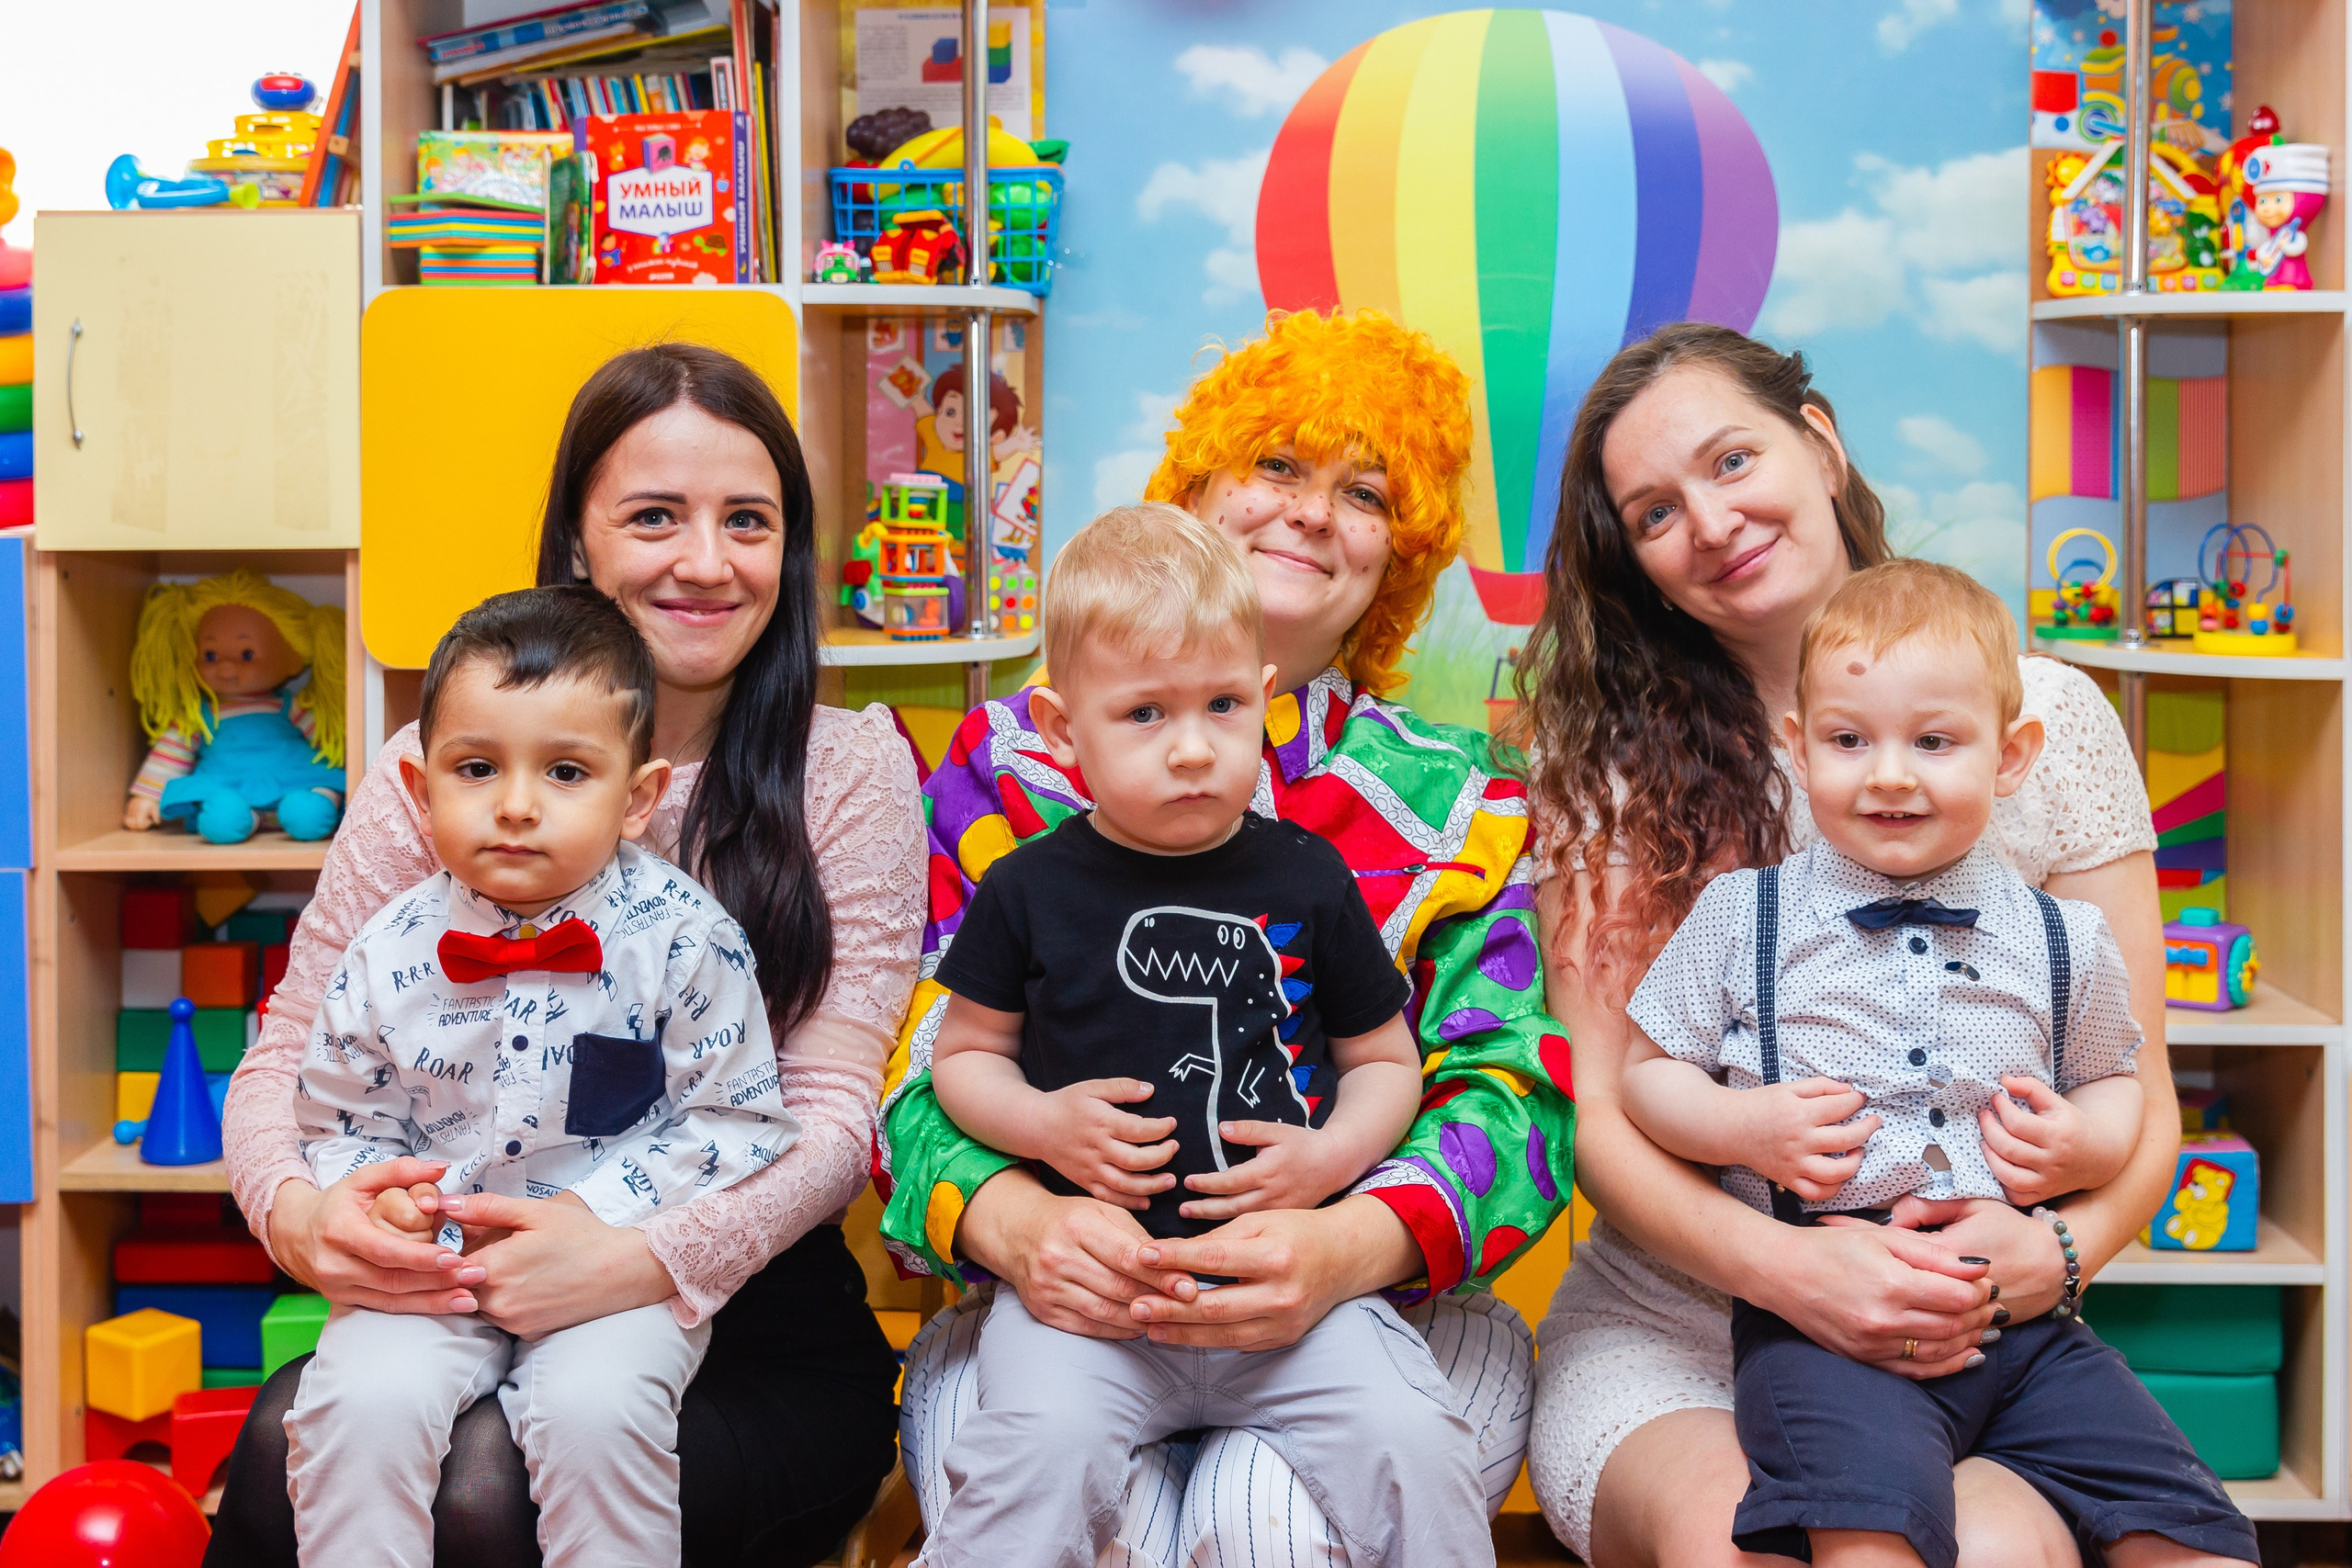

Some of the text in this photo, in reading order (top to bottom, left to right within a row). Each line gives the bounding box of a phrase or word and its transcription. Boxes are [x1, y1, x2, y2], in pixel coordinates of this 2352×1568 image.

[620, 176, 702, 198] УМНЫЙ
[619, 201, 703, 220] МАЛЫШ
[662, 878, 702, 910] R-R-R
[625, 896, 667, 923] ADVENT
[391, 962, 436, 993] R-R-R
[442, 996, 497, 1010] FANTASTIC
[438, 1009, 493, 1027] ADVENTURE
[688, 1018, 746, 1059] ROAR
[413, 1047, 473, 1085] ROAR
[730, 1074, 779, 1107] ADVENTUR
